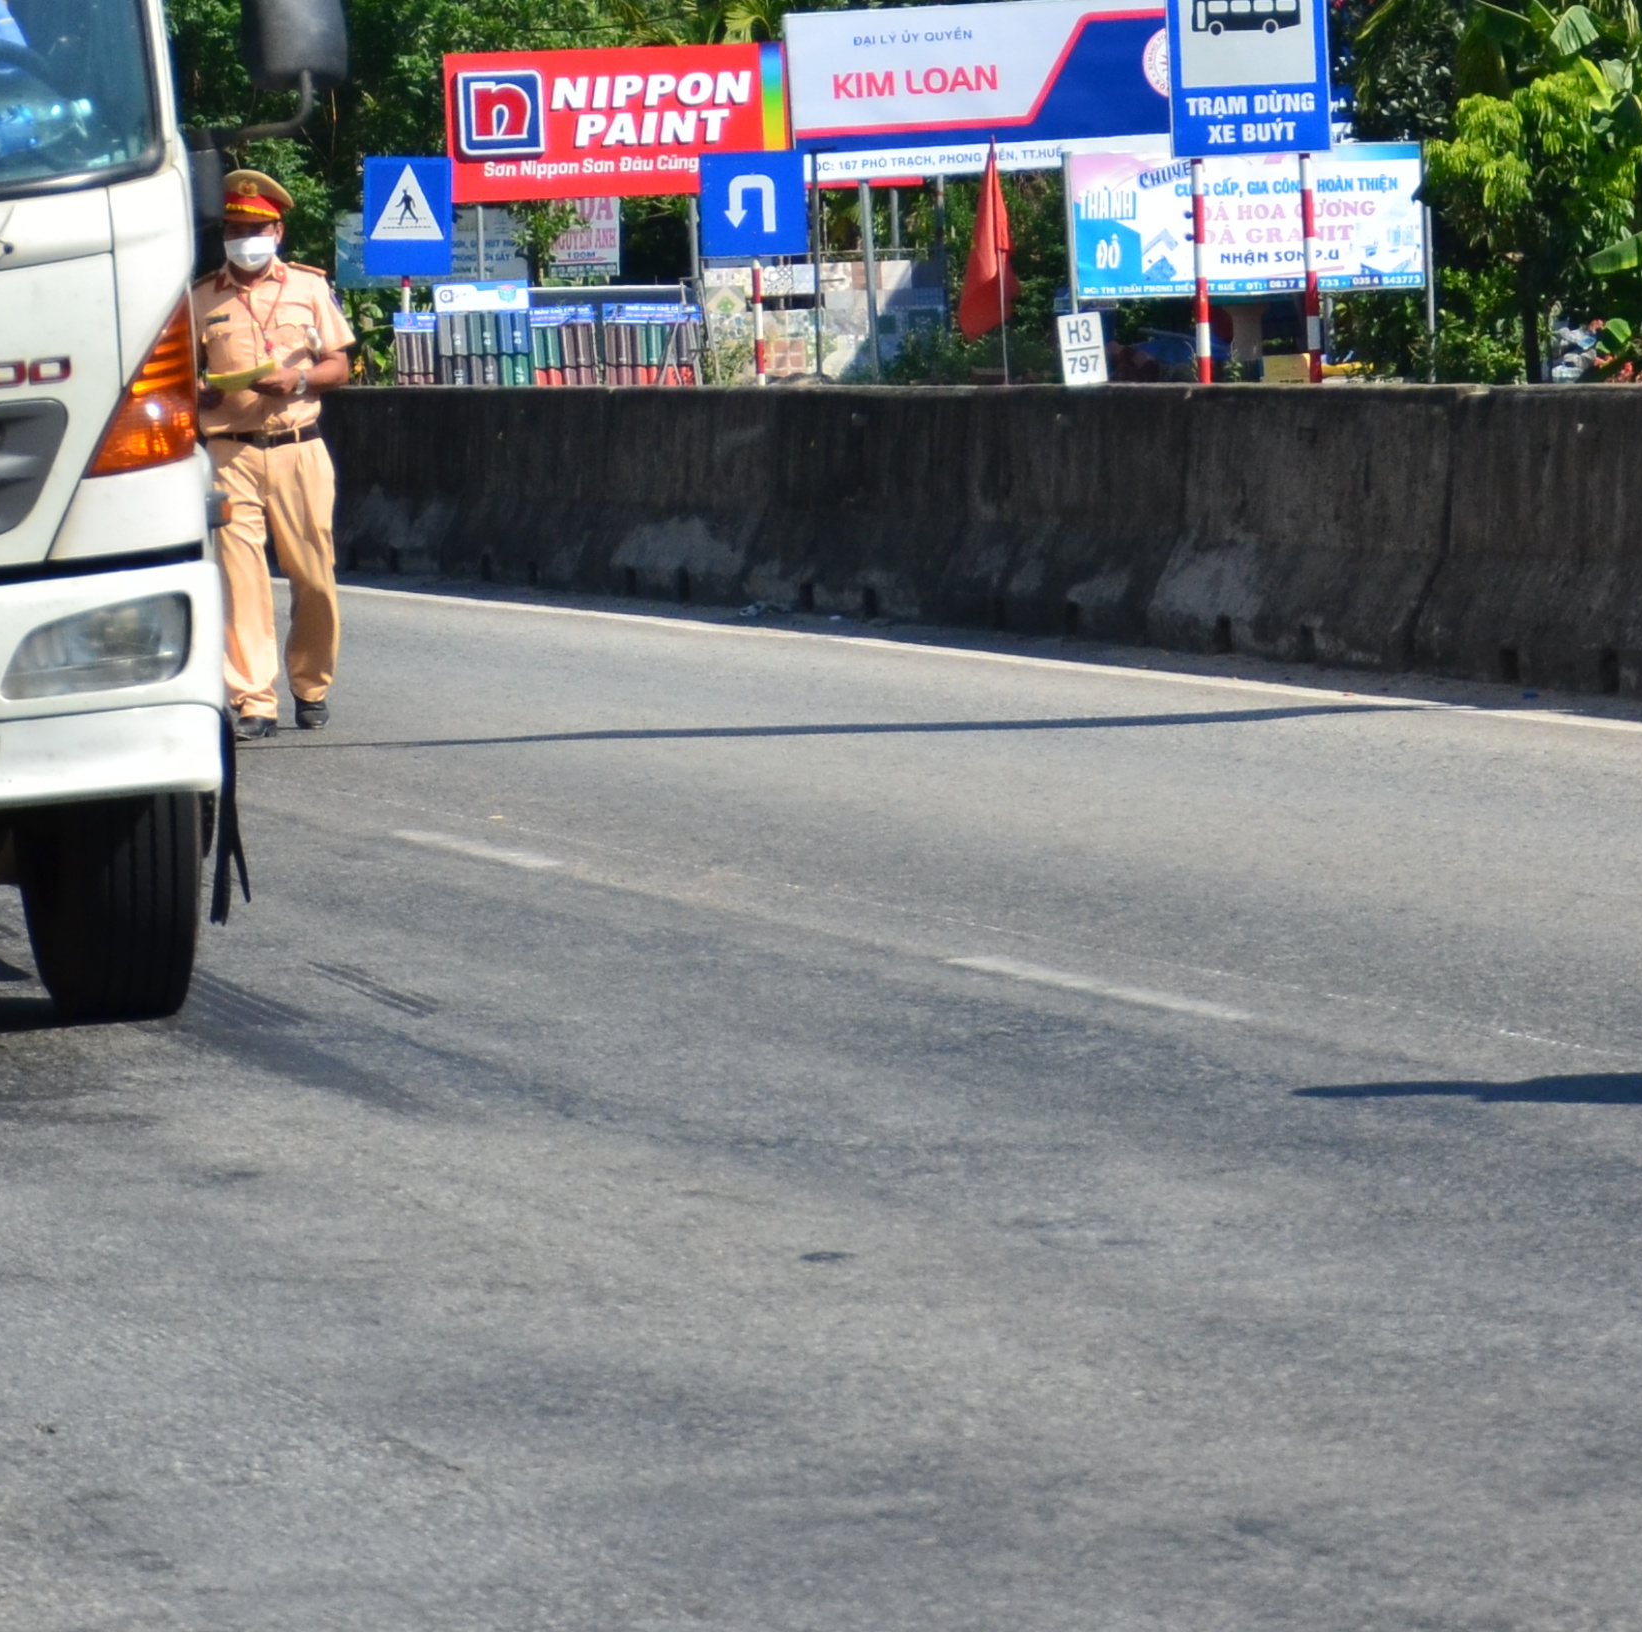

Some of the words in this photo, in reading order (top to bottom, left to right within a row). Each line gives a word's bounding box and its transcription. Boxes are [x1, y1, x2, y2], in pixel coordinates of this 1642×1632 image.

[853, 36, 876, 48] ĐẠI
[881, 32, 897, 45] LÝ
[902, 29, 920, 43] ỦY
[924, 27, 973, 42] QUYỀN
[550, 70, 752, 111] NIPPON
[833, 71, 895, 99] KIM
[905, 64, 998, 95] LOAN
[1186, 96, 1247, 118] TRẠM
[1253, 90, 1315, 114] DỪNG
[573, 108, 731, 149] PAINT
[1208, 124, 1236, 144] XE
[1242, 119, 1296, 142] BUÝT
[484, 162, 516, 178] Sơn
[520, 160, 579, 179] Nippon
[582, 158, 615, 174] Sơn
[656, 154, 700, 173] Cũng
[839, 160, 858, 171] 167
[939, 152, 982, 165] PHONG
[1174, 181, 1209, 197] CUG
[1213, 176, 1243, 198] CẤP,
[1247, 180, 1269, 195] GIA
[1273, 177, 1301, 194] CÔN
[1317, 175, 1354, 192] HOÀN
[1358, 174, 1398, 192] THIỆN
[1079, 185, 1137, 220] THÀNH
[1237, 203, 1286, 220] HOA
[1220, 249, 1268, 265] NHẬN
[1067, 318, 1092, 345] H3
[1067, 354, 1099, 375] 797
